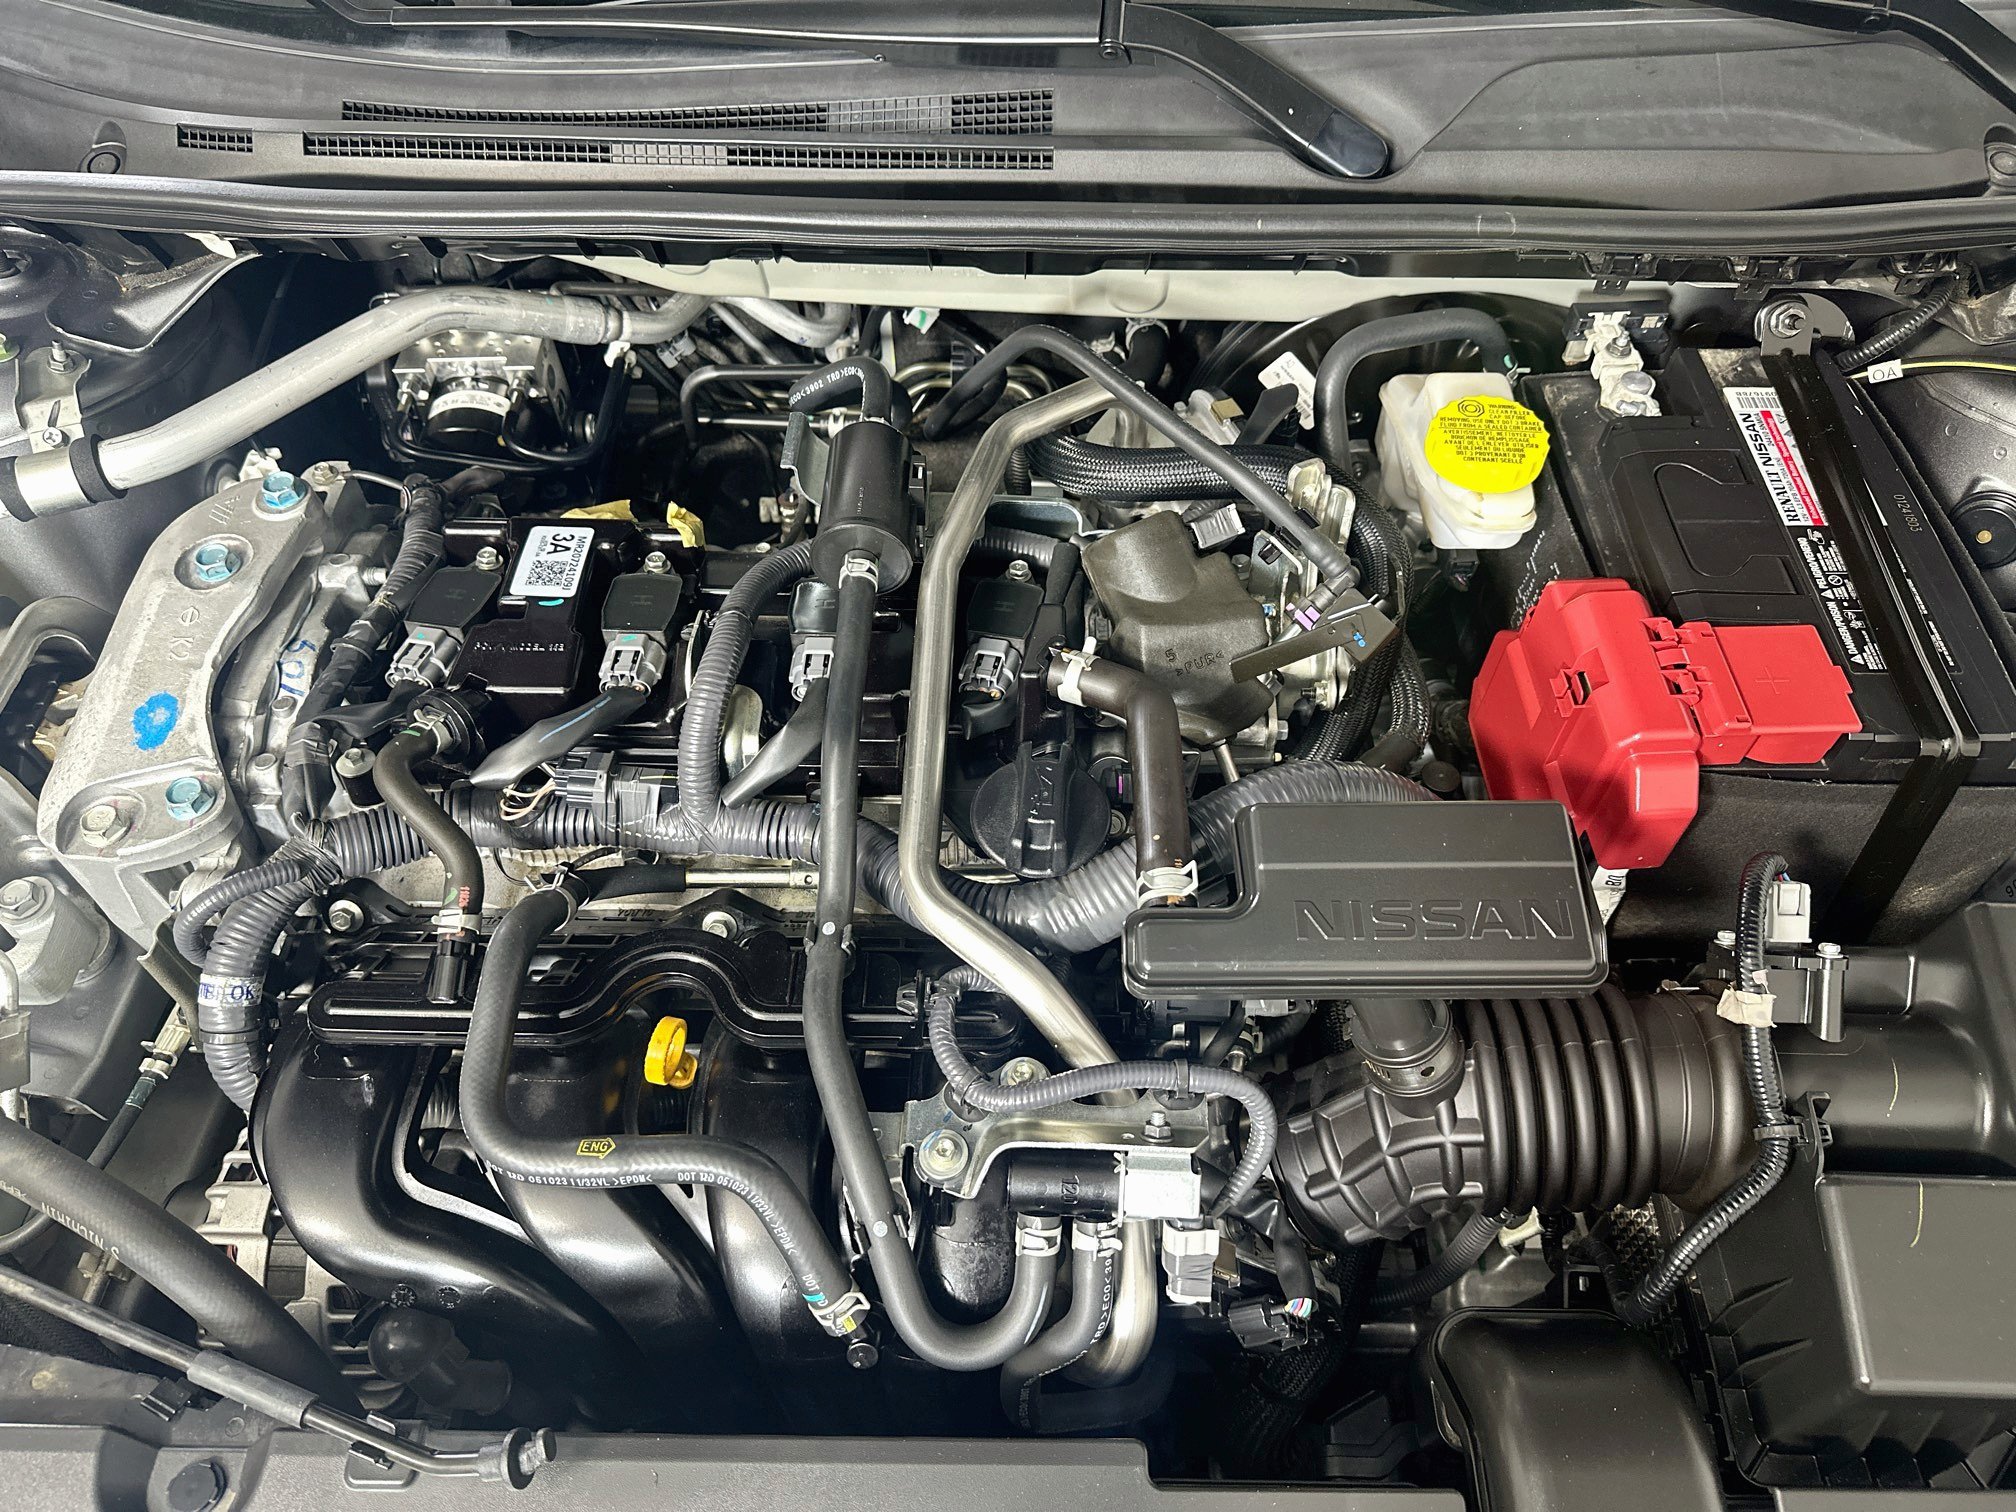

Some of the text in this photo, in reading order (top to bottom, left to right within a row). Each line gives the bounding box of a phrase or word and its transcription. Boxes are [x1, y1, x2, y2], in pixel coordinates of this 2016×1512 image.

[1739, 413, 1801, 522] RENAULT NISSAN
[547, 533, 575, 554] 3A
[1826, 601, 1858, 655] DANGER/POISON
[1165, 648, 1177, 662] 5
[1294, 900, 1574, 940] NISSAN
[582, 1141, 609, 1152] ENG
[528, 1176, 568, 1185] 051023
[612, 1174, 653, 1186] >EPDM<
[677, 1171, 696, 1181] DOT
[717, 1175, 750, 1195] 051023
[802, 1274, 819, 1292] DOT
